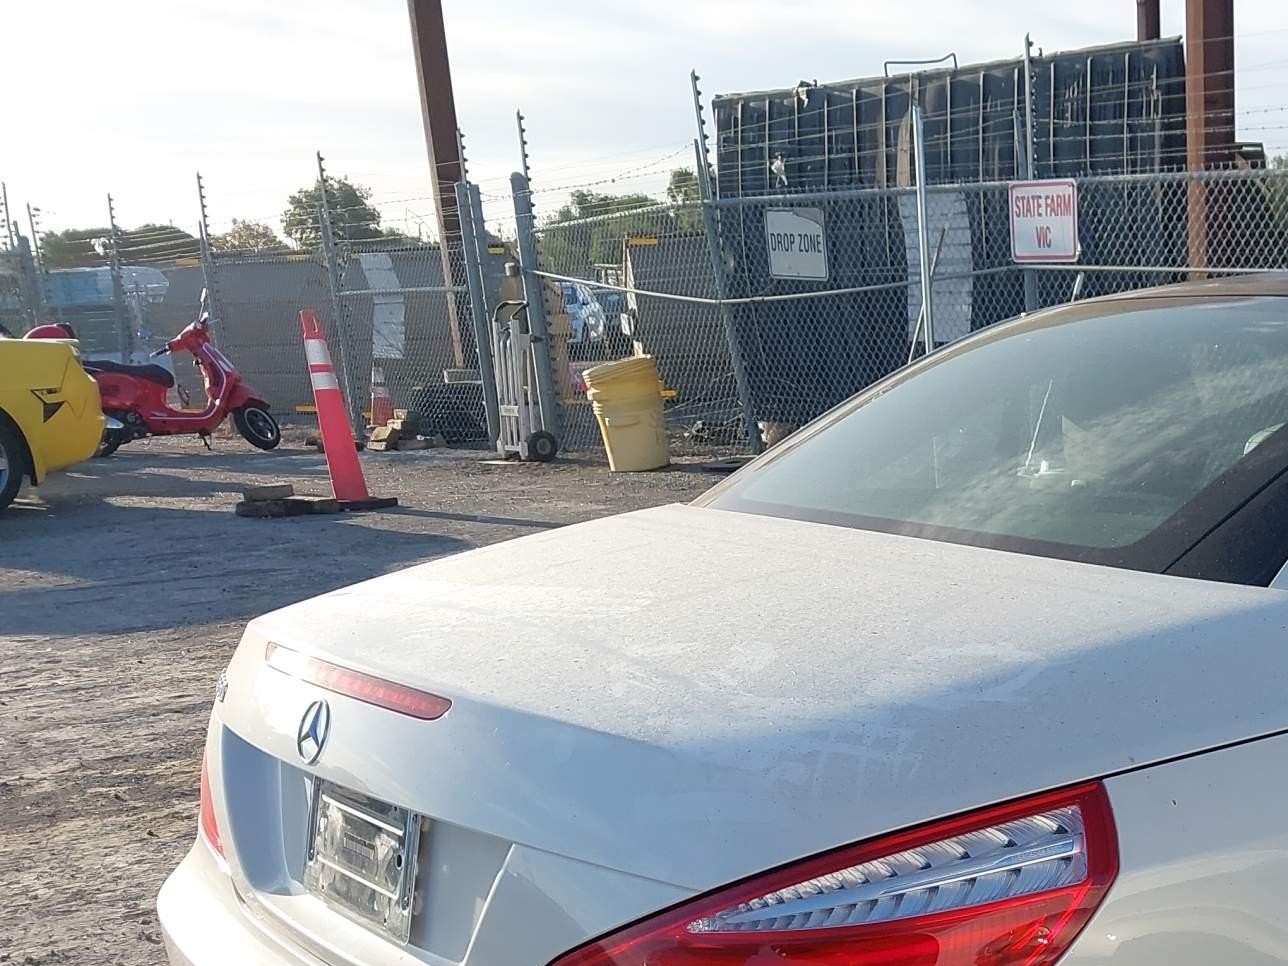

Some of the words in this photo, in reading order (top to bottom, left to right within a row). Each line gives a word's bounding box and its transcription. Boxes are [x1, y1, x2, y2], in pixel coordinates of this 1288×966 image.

[1014, 194, 1042, 218] STATE
[1044, 193, 1072, 217] FARM
[769, 233, 795, 252] DROP
[797, 233, 822, 253] ZONE
[1035, 225, 1052, 249] VIC
